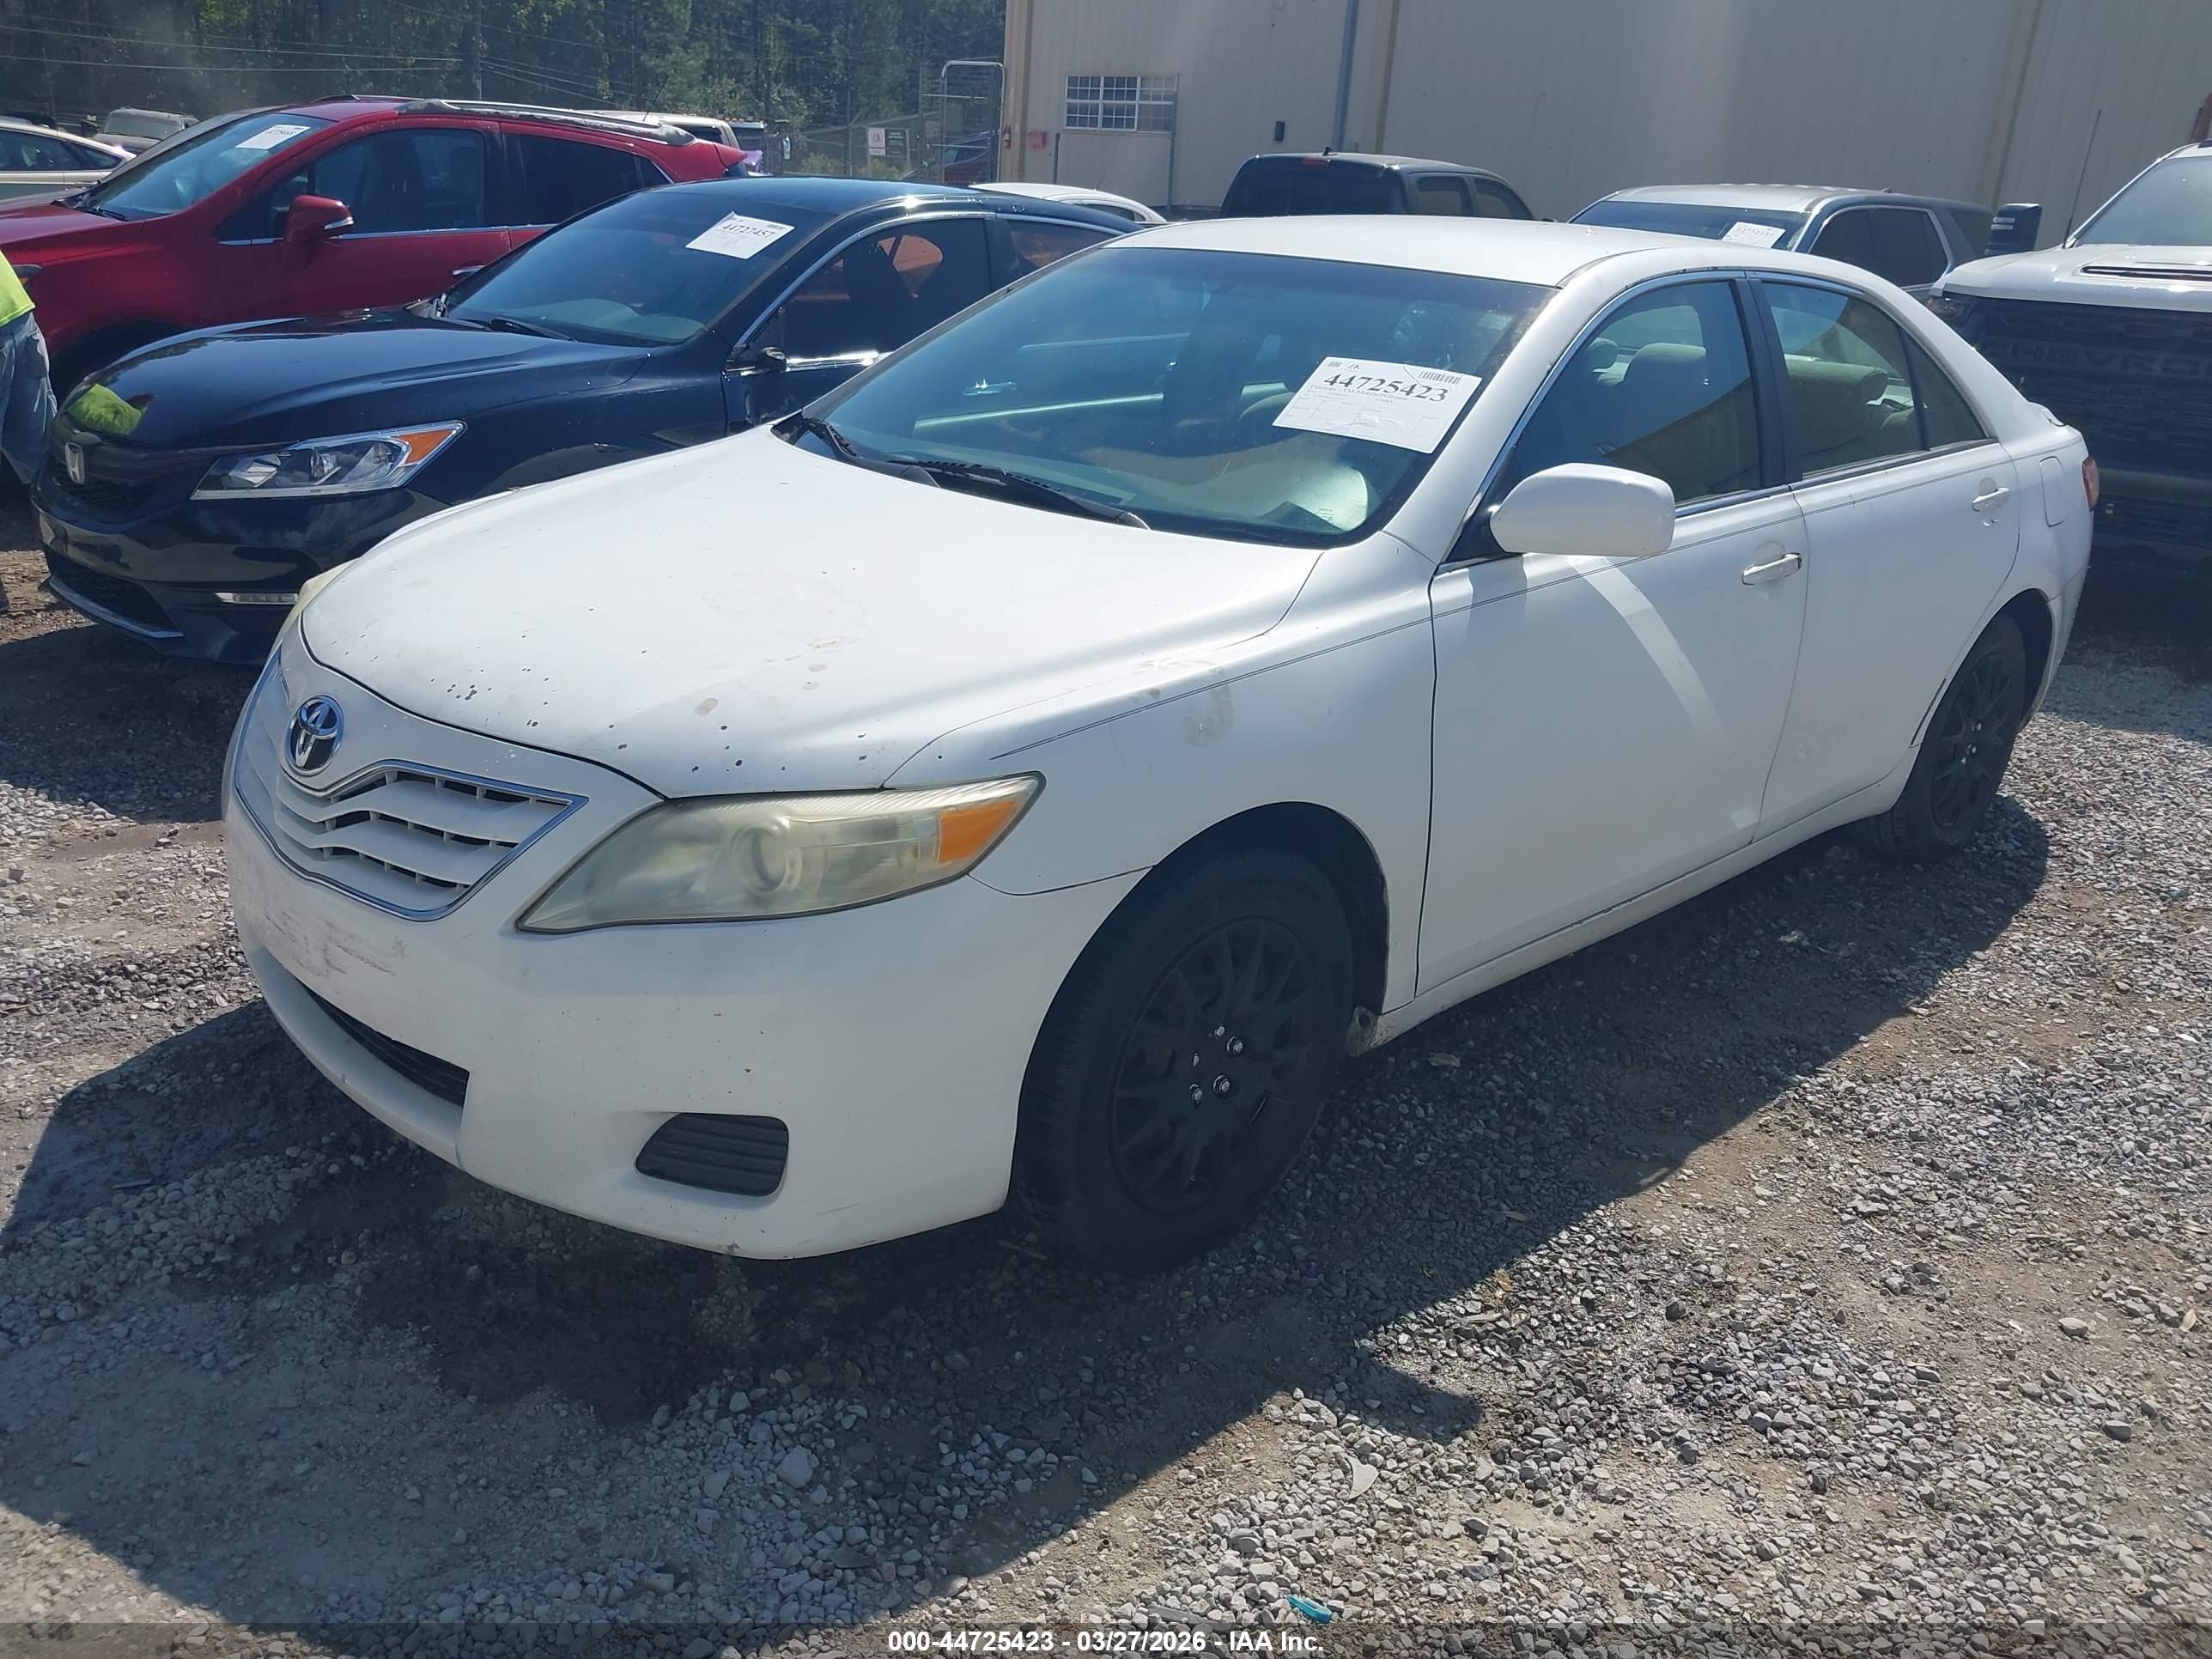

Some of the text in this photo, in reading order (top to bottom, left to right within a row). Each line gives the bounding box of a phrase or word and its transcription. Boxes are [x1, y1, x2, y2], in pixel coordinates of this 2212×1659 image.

[722, 223, 776, 239] 44727457
[1980, 338, 2212, 376] CHEVRO
[1323, 374, 1449, 403] 44725423
